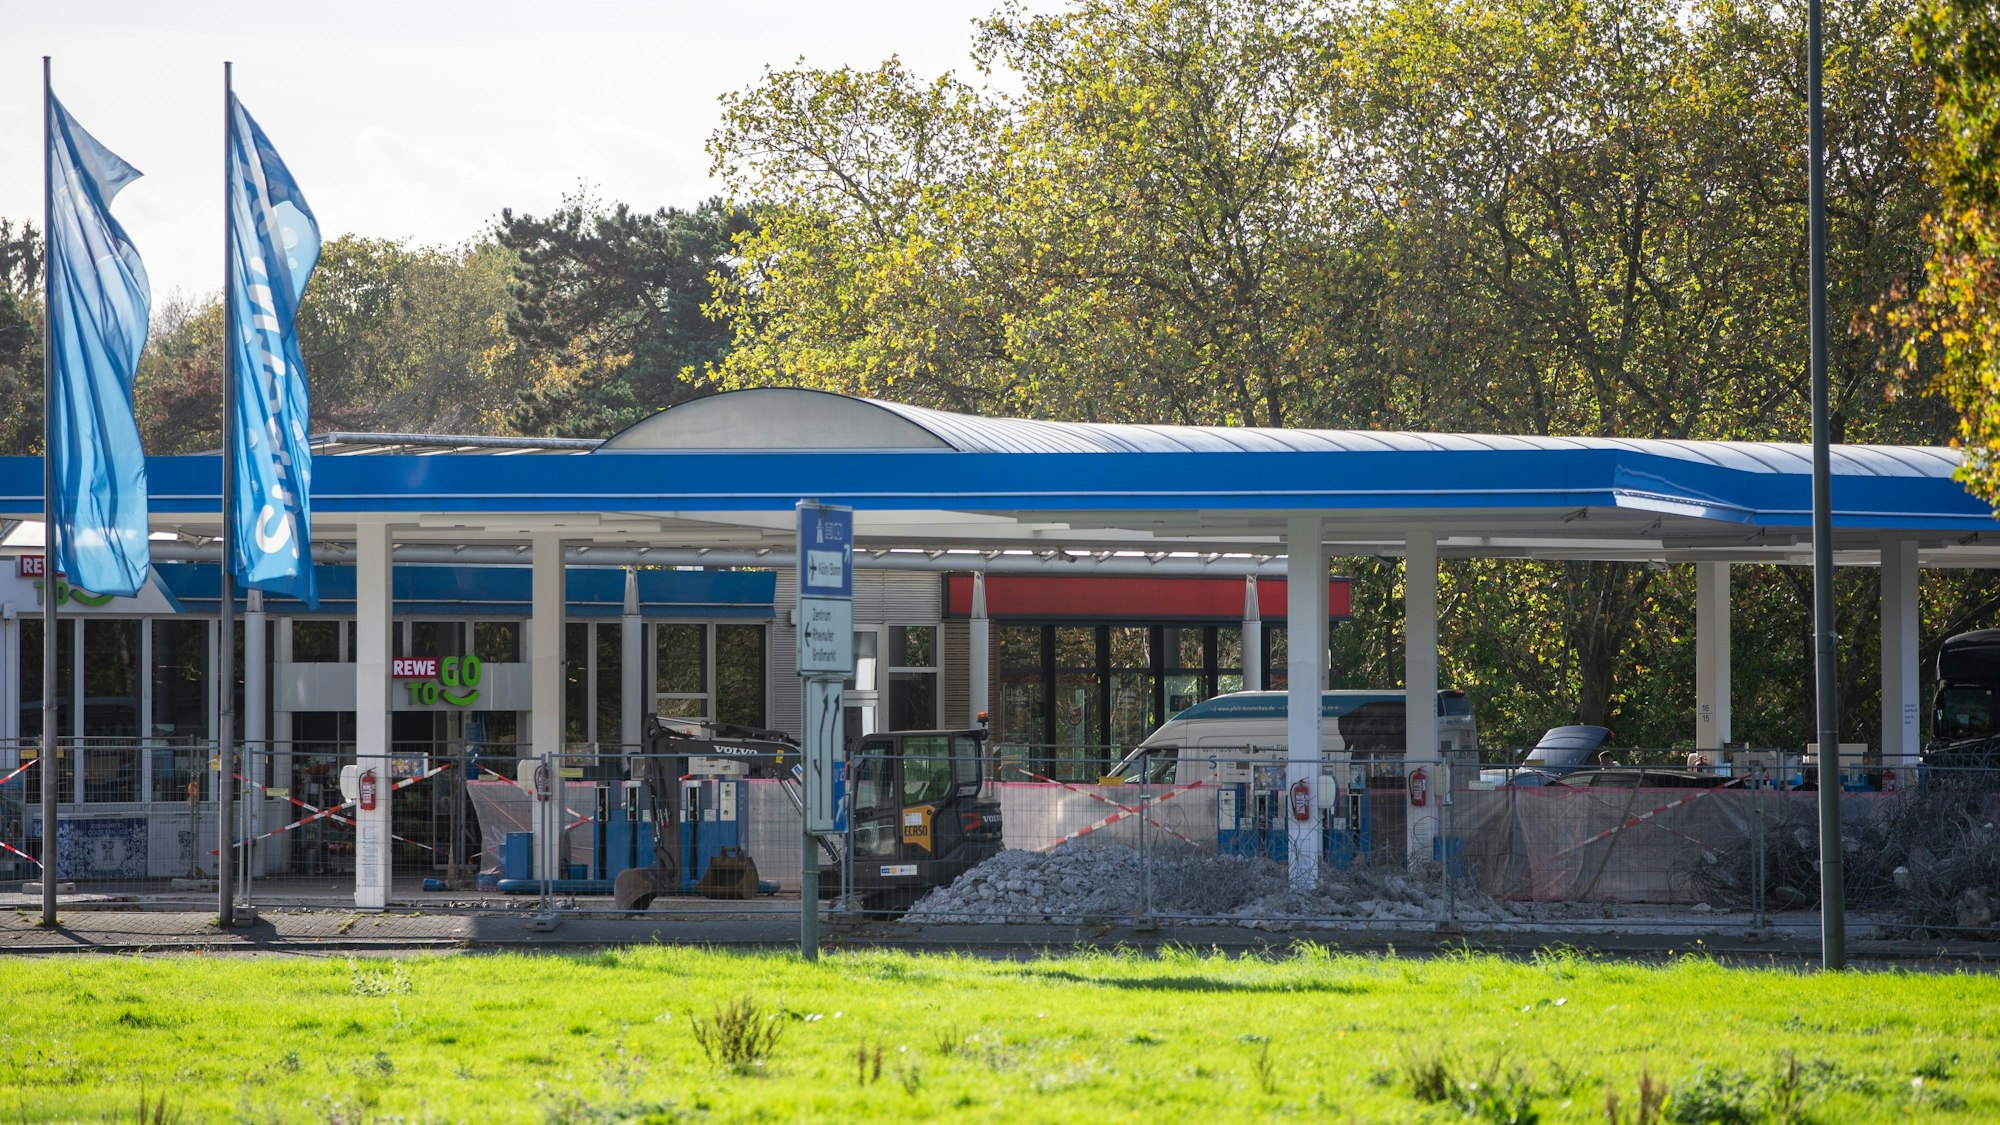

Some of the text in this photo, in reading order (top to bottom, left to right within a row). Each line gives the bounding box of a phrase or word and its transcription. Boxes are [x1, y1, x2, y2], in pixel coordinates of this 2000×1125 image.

[23, 557, 46, 574] RE
[812, 607, 832, 621] Zentrum
[812, 627, 834, 641] Rheinufer
[812, 648, 836, 662] Großmarkt
[393, 655, 481, 687] REWE GO
[406, 681, 439, 705] TO
[1702, 704, 1709, 712] 16
[1702, 714, 1709, 722] 15
[713, 745, 758, 755] VOLVO
[981, 814, 1002, 823] VOLV
[904, 825, 928, 837] ECR50
